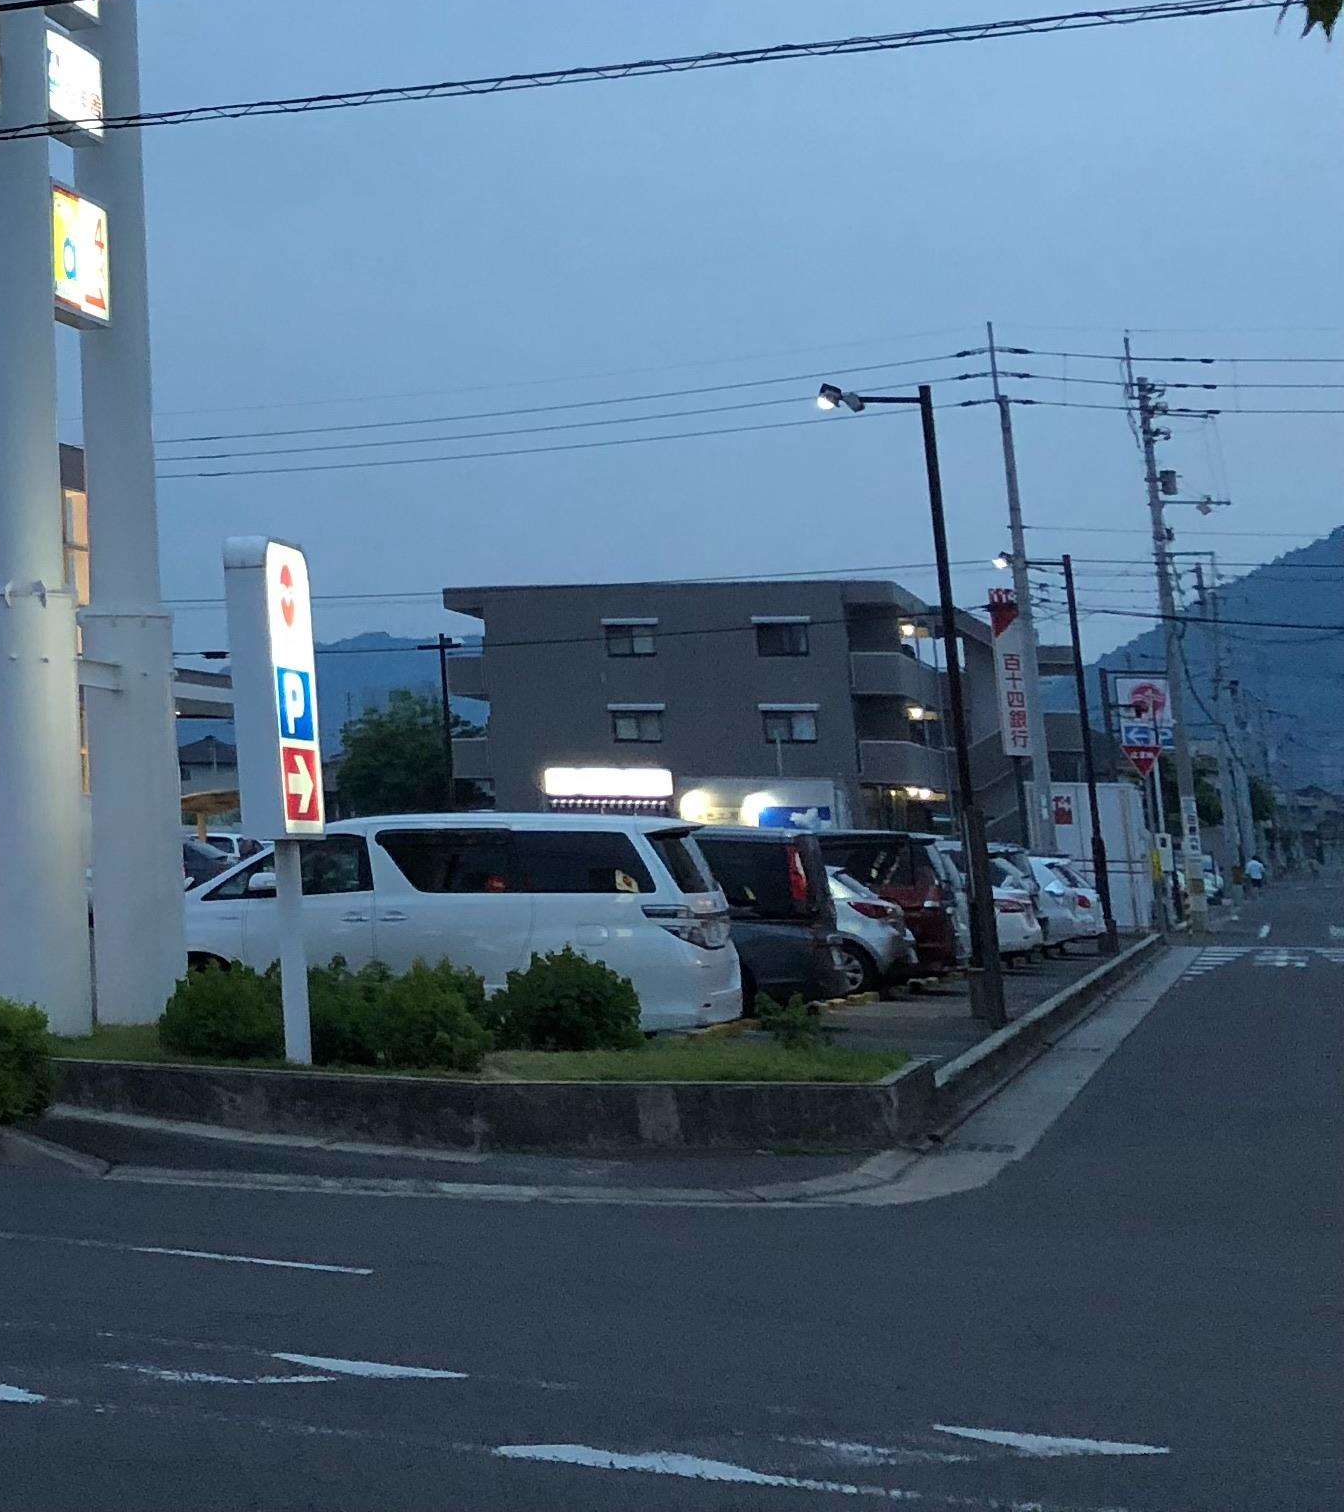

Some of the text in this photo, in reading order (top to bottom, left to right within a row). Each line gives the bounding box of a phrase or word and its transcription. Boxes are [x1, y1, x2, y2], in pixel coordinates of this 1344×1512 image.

[282, 672, 305, 735] P
[1002, 653, 1029, 749] 百十四銀行
